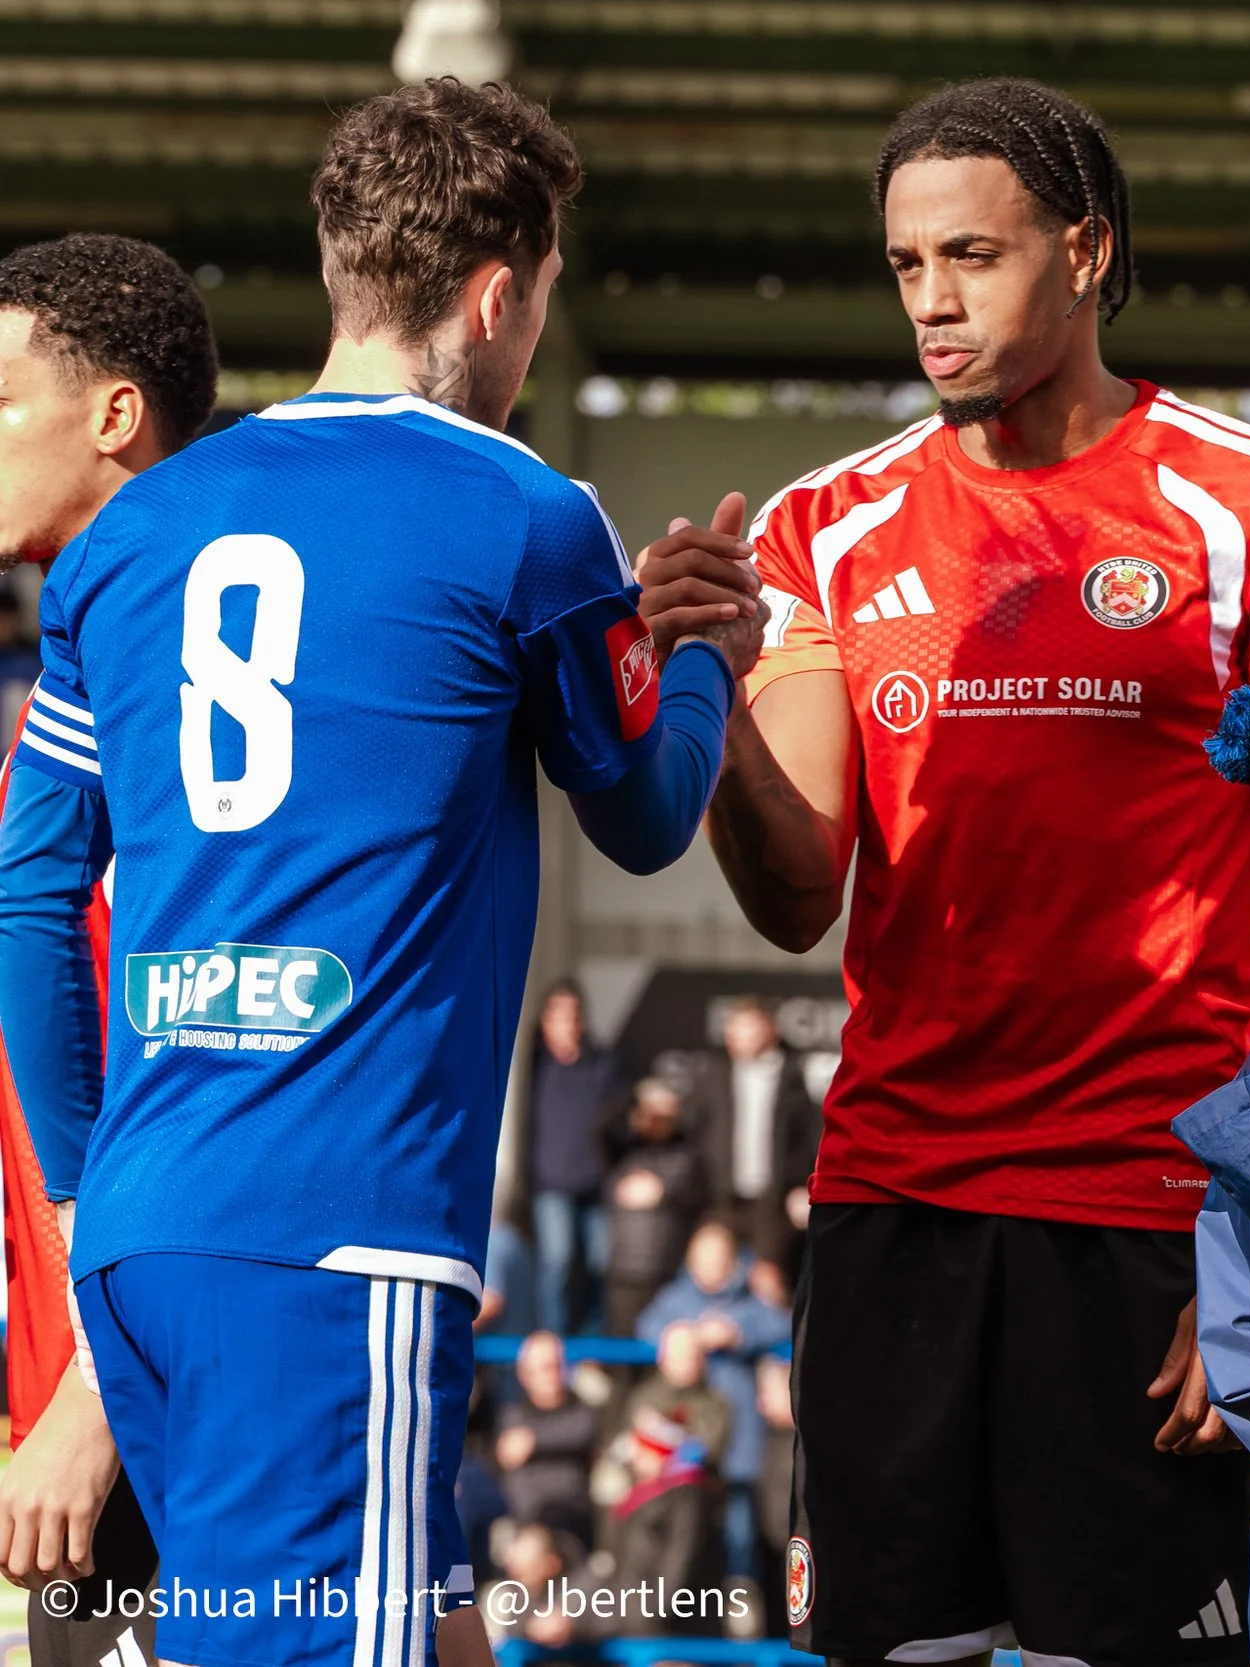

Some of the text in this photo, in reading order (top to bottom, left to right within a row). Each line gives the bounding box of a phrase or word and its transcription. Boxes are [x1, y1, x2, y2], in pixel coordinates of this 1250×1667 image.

[1124, 560, 1157, 575] UNITED
[1092, 608, 1155, 626] FOOTBALL CLUB
[179, 534, 305, 833] 8
[937, 677, 1142, 703] PROJECT SOLAR
[937, 707, 1141, 719] YOUR INDEPENDENT & NATIONWIDE TRUSTED ADVISOR
[179, 1030, 236, 1050] HOUSING
